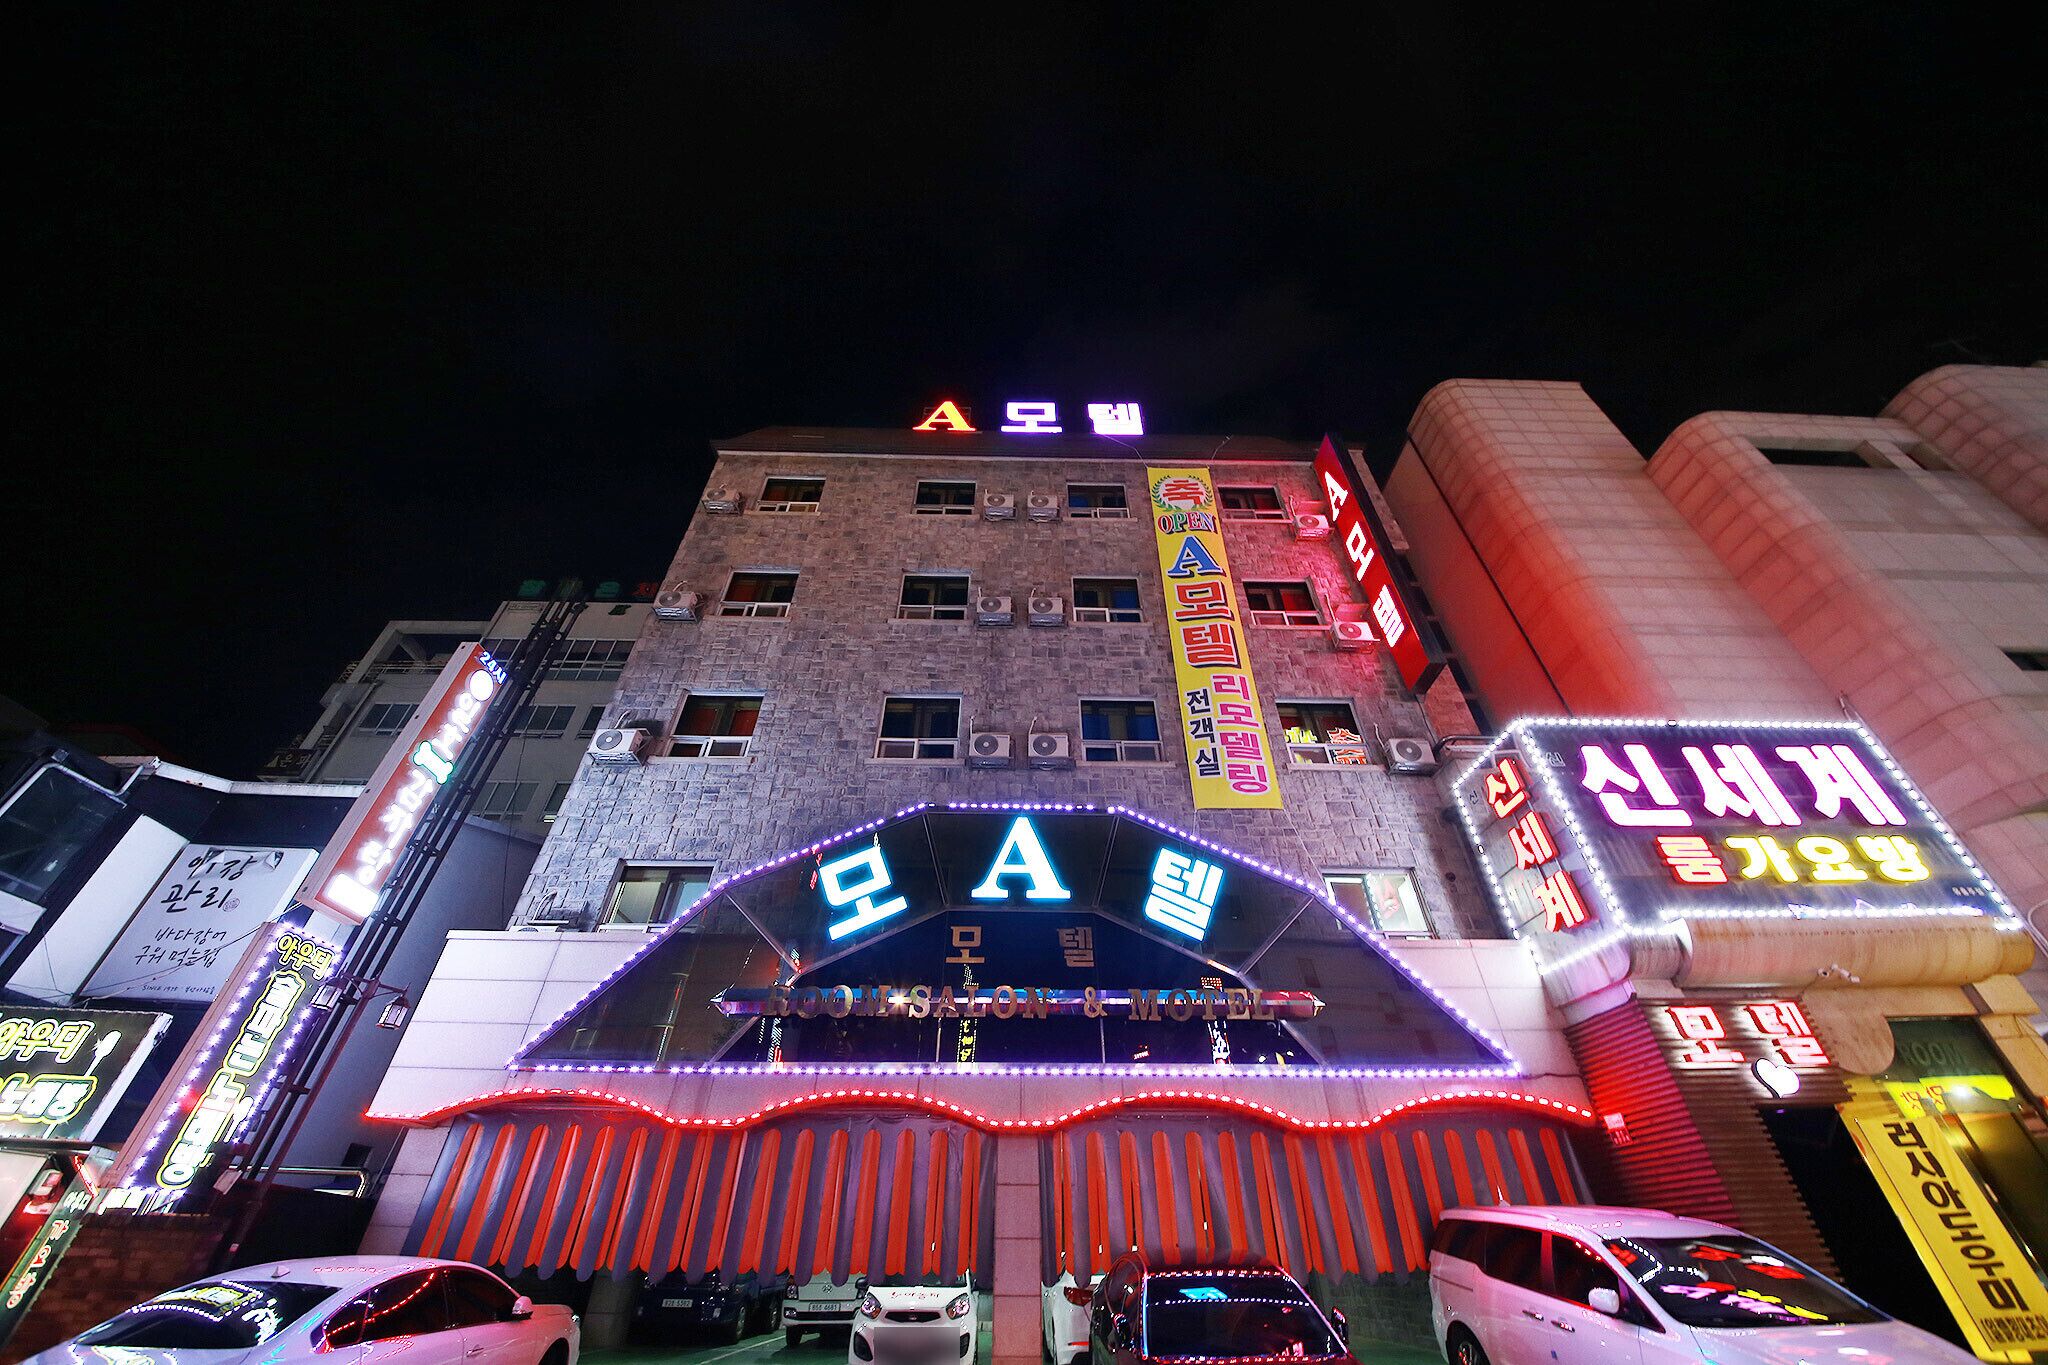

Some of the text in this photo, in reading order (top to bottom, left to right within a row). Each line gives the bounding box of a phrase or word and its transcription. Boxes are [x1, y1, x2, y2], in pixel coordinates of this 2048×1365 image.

[1162, 478, 1205, 506] 축
[1157, 511, 1219, 534] OPEN
[478, 650, 508, 685] 24시
[1185, 688, 1222, 778] 전객실
[1210, 673, 1269, 796] 리모델링
[1578, 743, 1909, 828] 신세계
[356, 768, 434, 886] 감자탕
[1485, 757, 1592, 933] 신세계
[160, 879, 234, 914] 관리
[134, 945, 167, 965] 구워
[154, 926, 227, 945] 바다장어
[277, 932, 334, 980] 아우디
[762, 984, 1275, 1021] ROOM SALON & MOTEL
[0, 1018, 95, 1063] 아우디
[1883, 1122, 2030, 1311] 러시아도우미
